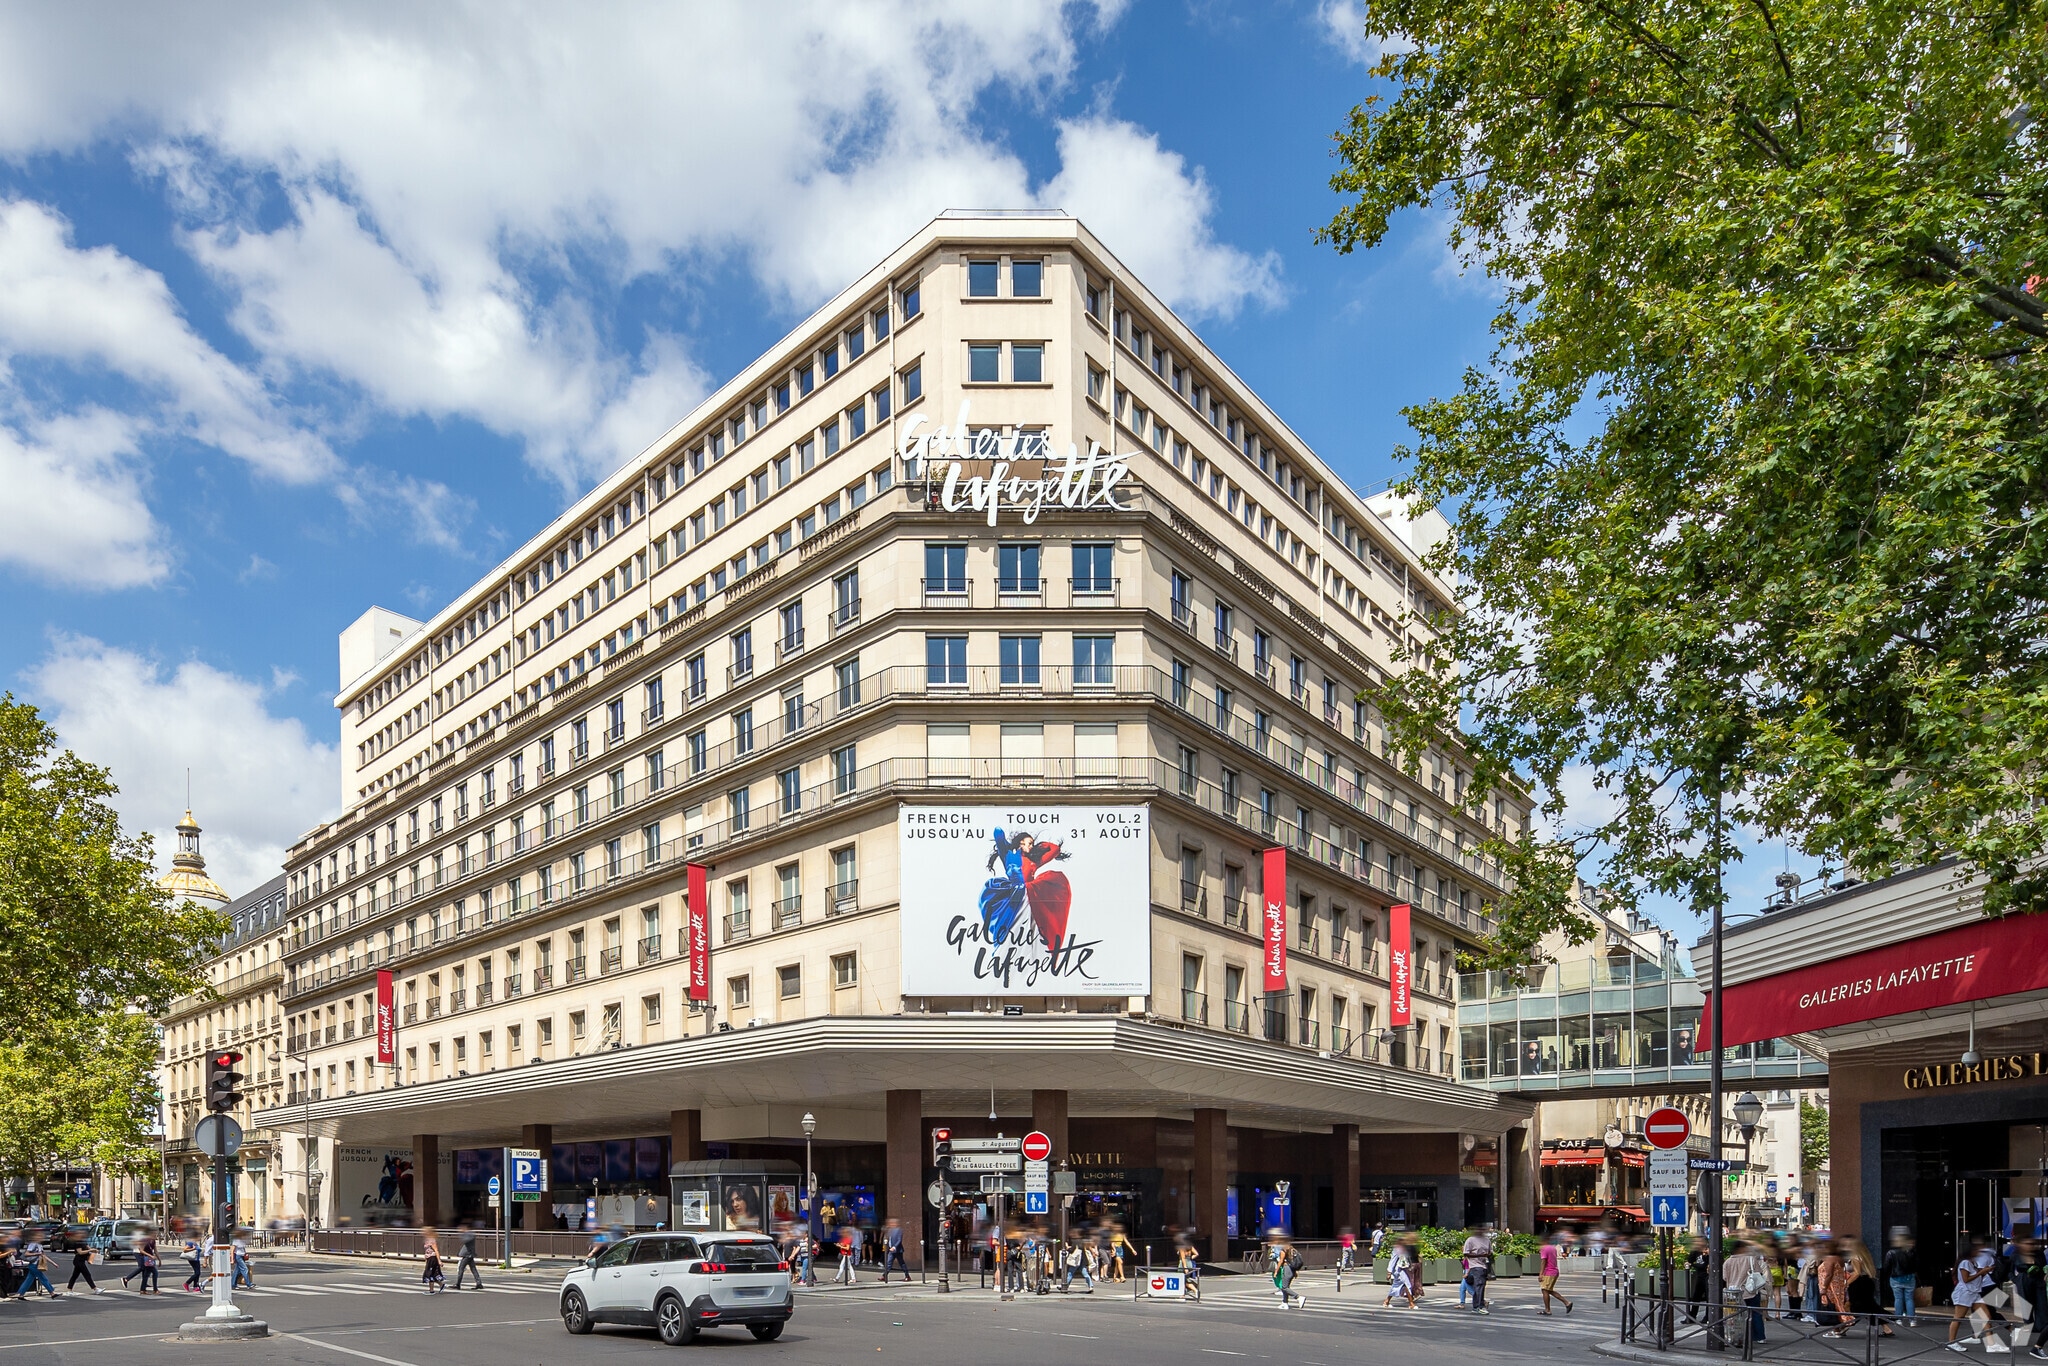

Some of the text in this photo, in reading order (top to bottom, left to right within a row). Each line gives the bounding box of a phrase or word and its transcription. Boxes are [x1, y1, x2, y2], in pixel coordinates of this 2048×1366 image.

[900, 399, 1059, 477] Galeries
[941, 441, 1143, 527] Lafayette
[907, 813, 1142, 824] FRENCH TOUCH VOL.2
[907, 826, 1142, 839] JUSQU'AU 31 AOÛT
[946, 904, 1049, 955] Galeries
[1266, 901, 1284, 977] Galeries Lafayette
[691, 911, 707, 987] Galeries Lafayette
[973, 934, 1104, 988] Lafayette
[1392, 949, 1409, 1013] Galeries Lafayette
[1799, 954, 1976, 1009] GALERIES LAFAYETTE
[1903, 1055, 2024, 1090] GALERIES
[990, 1140, 1017, 1148] Augustin
[1070, 1153, 1125, 1164] AYETTE
[1559, 1140, 1587, 1148] CAFE
[516, 1160, 532, 1182] P
[1690, 1159, 1716, 1169] Toilettes
[78, 1184, 87, 1195] P
